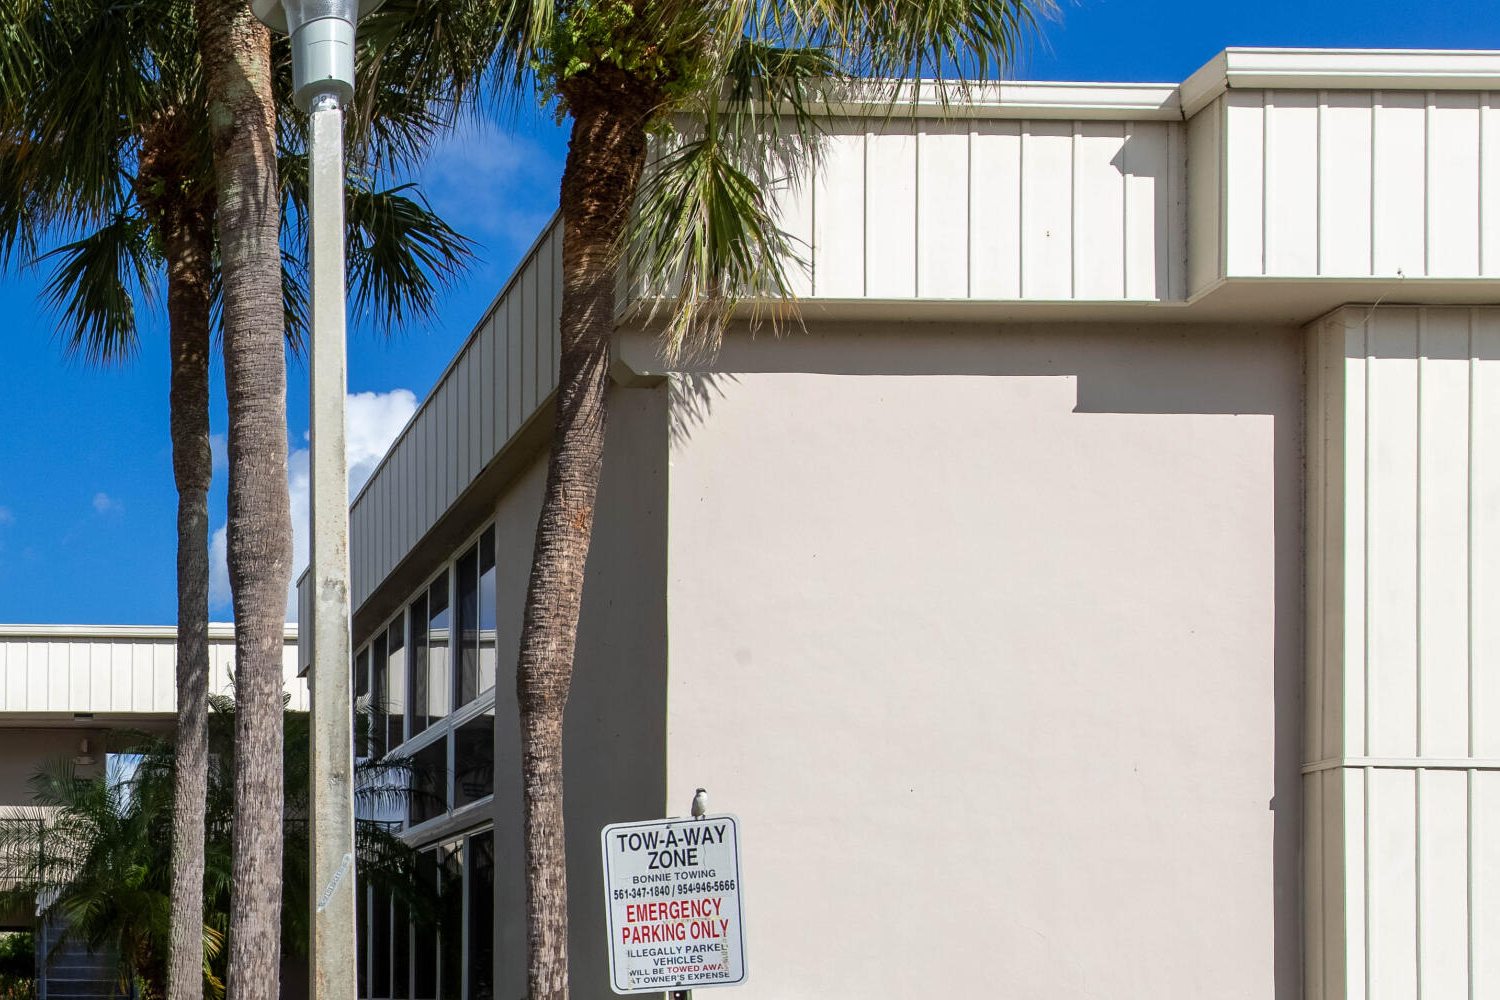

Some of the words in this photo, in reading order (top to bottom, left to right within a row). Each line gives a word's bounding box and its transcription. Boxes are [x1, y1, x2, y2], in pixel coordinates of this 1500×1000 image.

[616, 824, 726, 852] TOW-A-WAY
[648, 848, 698, 869] ZONE
[632, 872, 672, 884] BONNIE
[674, 869, 716, 880] TOWING
[613, 885, 670, 900] 561-347-1840
[677, 879, 735, 895] 954-946-5666
[626, 897, 722, 923] EMERGENCY
[622, 922, 686, 945] PARKING
[690, 918, 729, 940] ONLY
[627, 946, 682, 958] ILLEGALLY
[653, 955, 704, 966] VEHICLES
[643, 973, 685, 984] OWNER'S
[687, 971, 730, 981] EXPENSE
[652, 967, 664, 975] BE
[667, 965, 700, 973] TOWED
